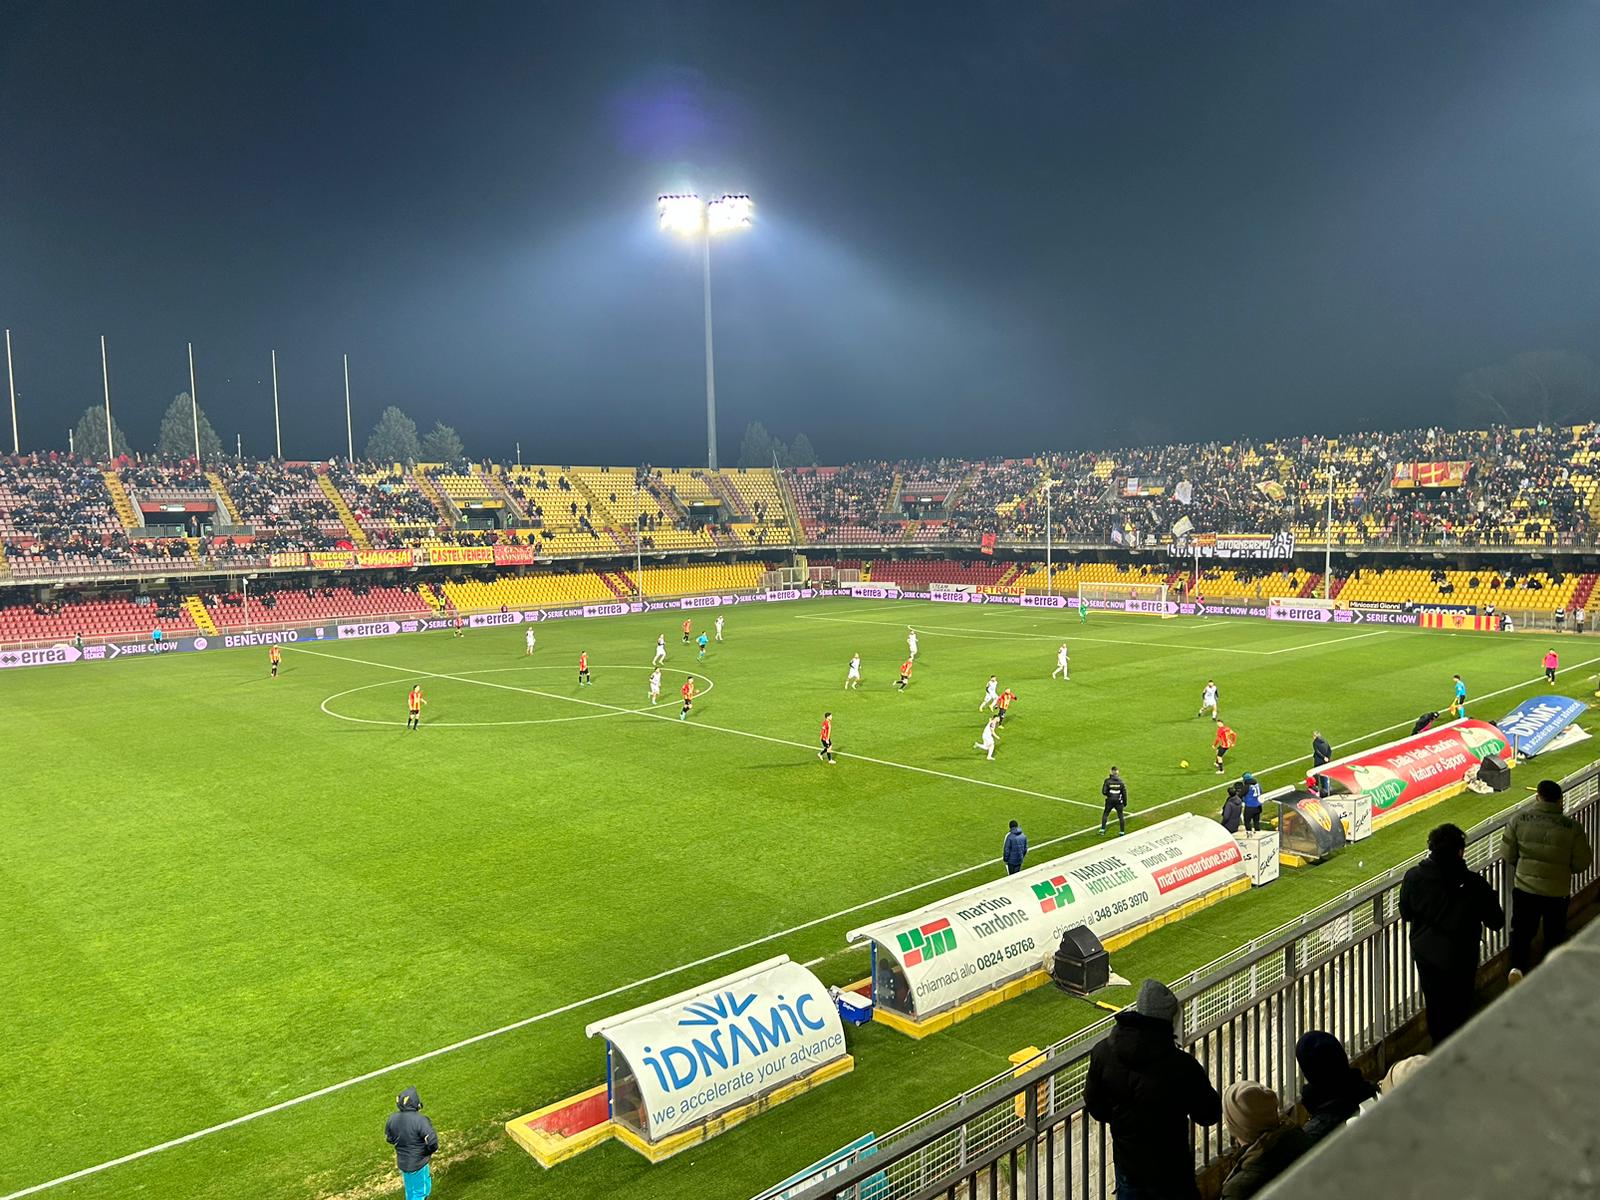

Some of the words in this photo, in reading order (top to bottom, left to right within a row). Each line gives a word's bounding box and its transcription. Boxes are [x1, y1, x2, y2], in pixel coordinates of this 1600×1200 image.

[598, 605, 622, 615] errea
[693, 597, 714, 606] errea
[1034, 597, 1058, 607] errea
[1206, 606, 1224, 614] SERIE
[1225, 607, 1230, 615] C
[1231, 607, 1248, 615] NOW
[486, 613, 514, 625] errea
[1289, 608, 1321, 620] errea
[1366, 613, 1387, 622] SERIE
[1388, 614, 1394, 622] C
[1396, 615, 1416, 624] NOW
[225, 631, 298, 647] BENEVENTO
[357, 623, 389, 635] errea
[21, 649, 66, 664] errea
[121, 644, 146, 654] SERIE
[148, 643, 154, 652] C
[1410, 764, 1437, 782] Natura
[1370, 782, 1400, 807] MAURO
[1127, 842, 1151, 857] visita
[1156, 833, 1183, 847] nostro
[1141, 853, 1167, 869] nuovo
[1165, 846, 1182, 859] sito
[1071, 856, 1126, 882] NARDONE
[1158, 848, 1238, 888] martinonardone.com
[1085, 867, 1138, 895] HOTELLERIE
[956, 895, 1011, 921] martino
[1088, 912, 1095, 926] al
[1094, 906, 1111, 922] 348
[1112, 899, 1129, 915] 365
[1129, 891, 1149, 908] 3970
[972, 908, 1029, 938] nardone
[916, 967, 960, 998] chiamaci
[961, 961, 977, 978] allo
[977, 950, 1004, 971] 0824
[1005, 937, 1035, 959] 58768
[643, 993, 825, 1092] iDNAMiC
[653, 1107, 675, 1124] we
[680, 1072, 754, 1113] accelerate
[757, 1056, 786, 1082] your
[791, 1034, 842, 1064] advance
